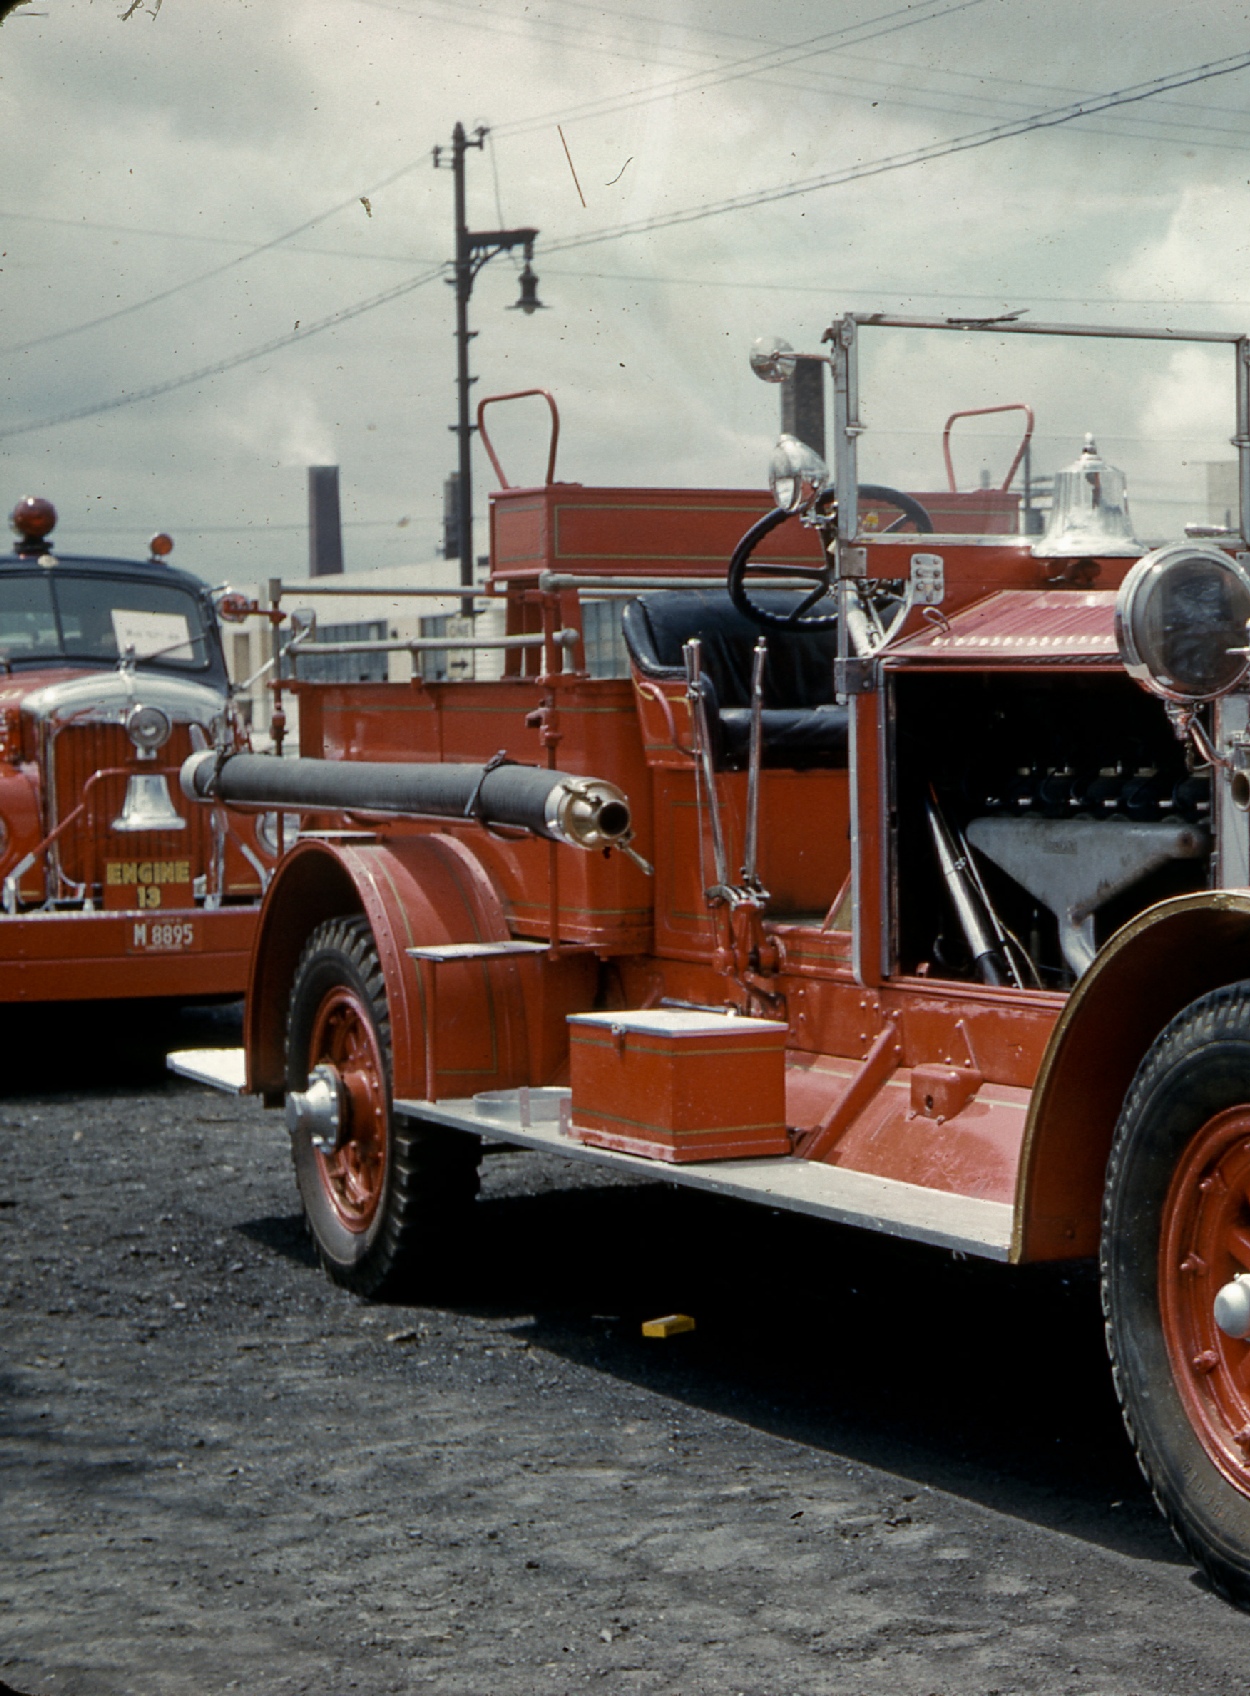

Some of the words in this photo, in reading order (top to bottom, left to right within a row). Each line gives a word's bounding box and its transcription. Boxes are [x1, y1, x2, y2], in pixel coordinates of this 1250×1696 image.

[106, 861, 190, 884] ENGINE
[137, 885, 161, 908] 13
[134, 923, 147, 946] M
[152, 923, 194, 945] 8895
